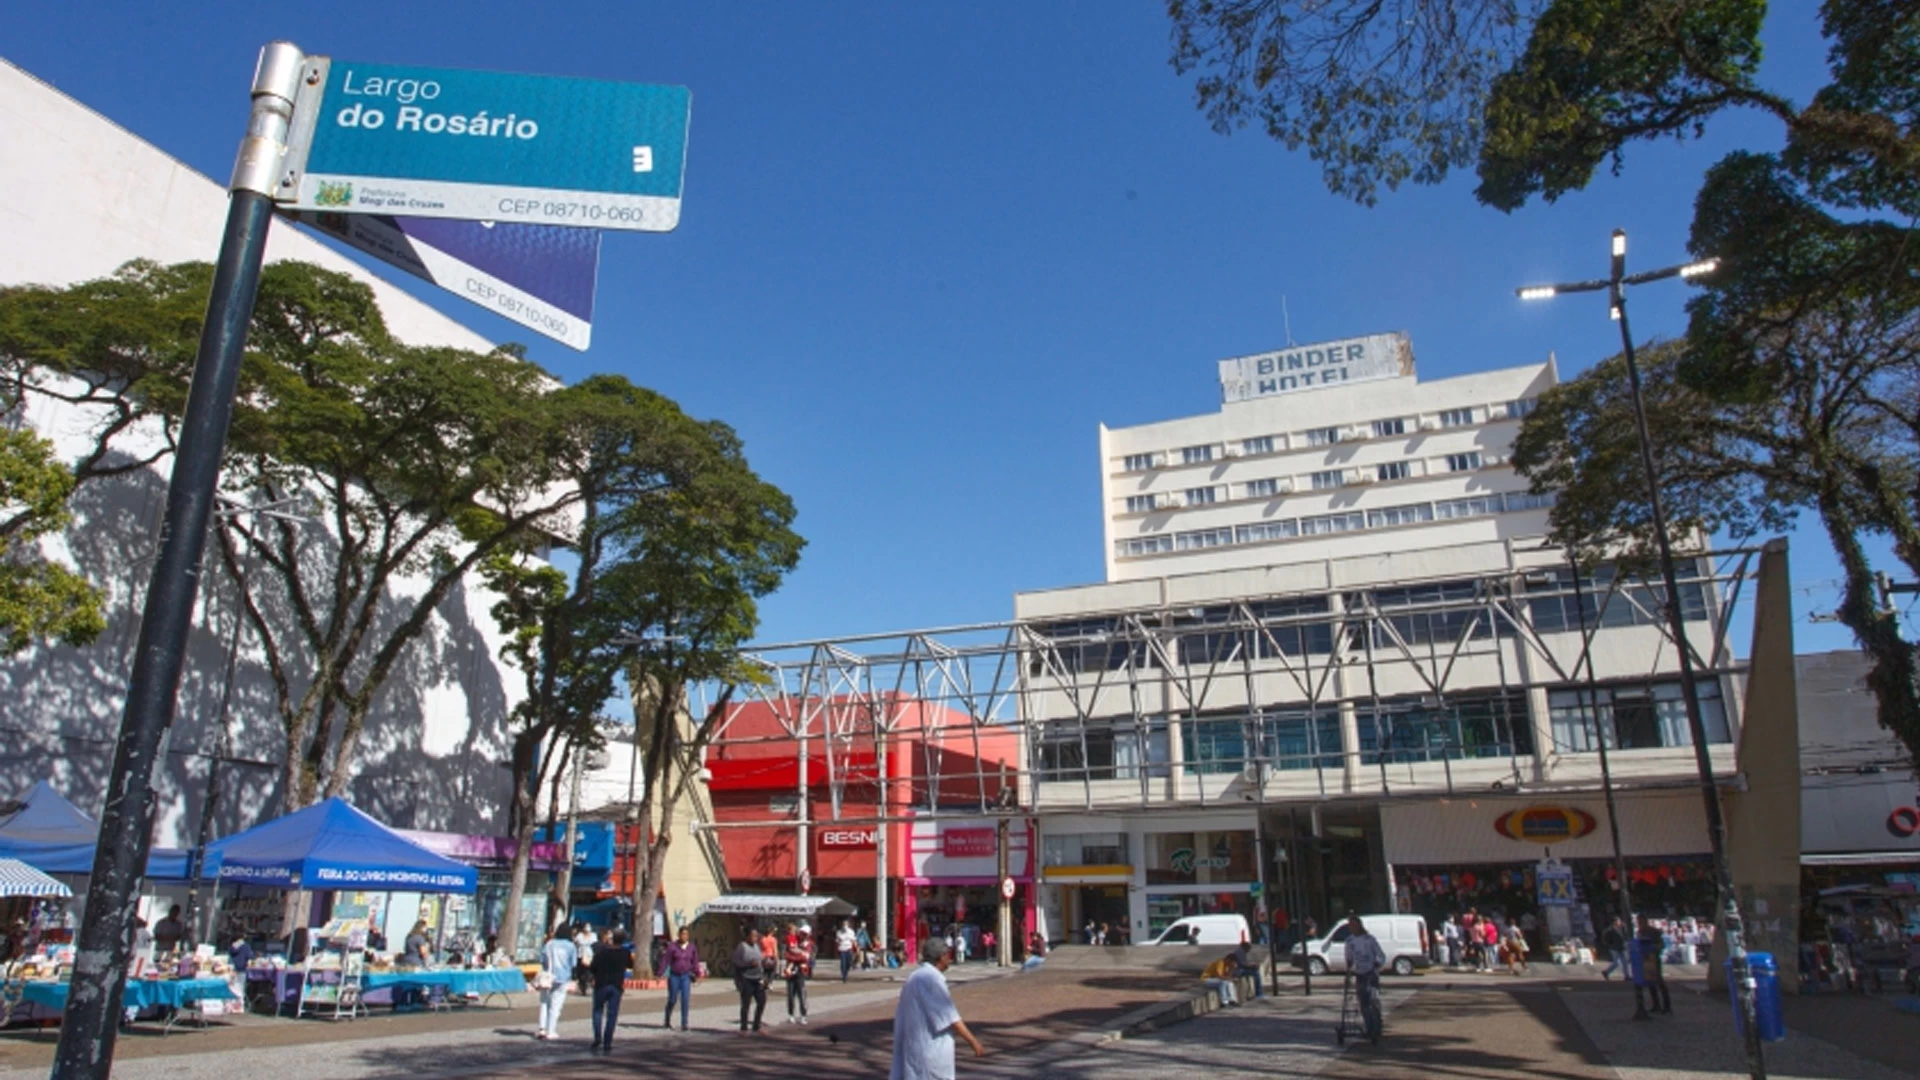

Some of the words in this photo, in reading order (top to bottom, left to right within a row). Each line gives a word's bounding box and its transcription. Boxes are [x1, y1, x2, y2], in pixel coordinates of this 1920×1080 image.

[343, 70, 441, 103] Largo
[337, 103, 385, 129] do
[396, 106, 539, 140] Rosário
[498, 198, 540, 214] CEP
[543, 202, 643, 221] 08710-060
[466, 278, 497, 299] CEP
[498, 294, 569, 336] 08710-060
[1256, 343, 1366, 375] BINDER
